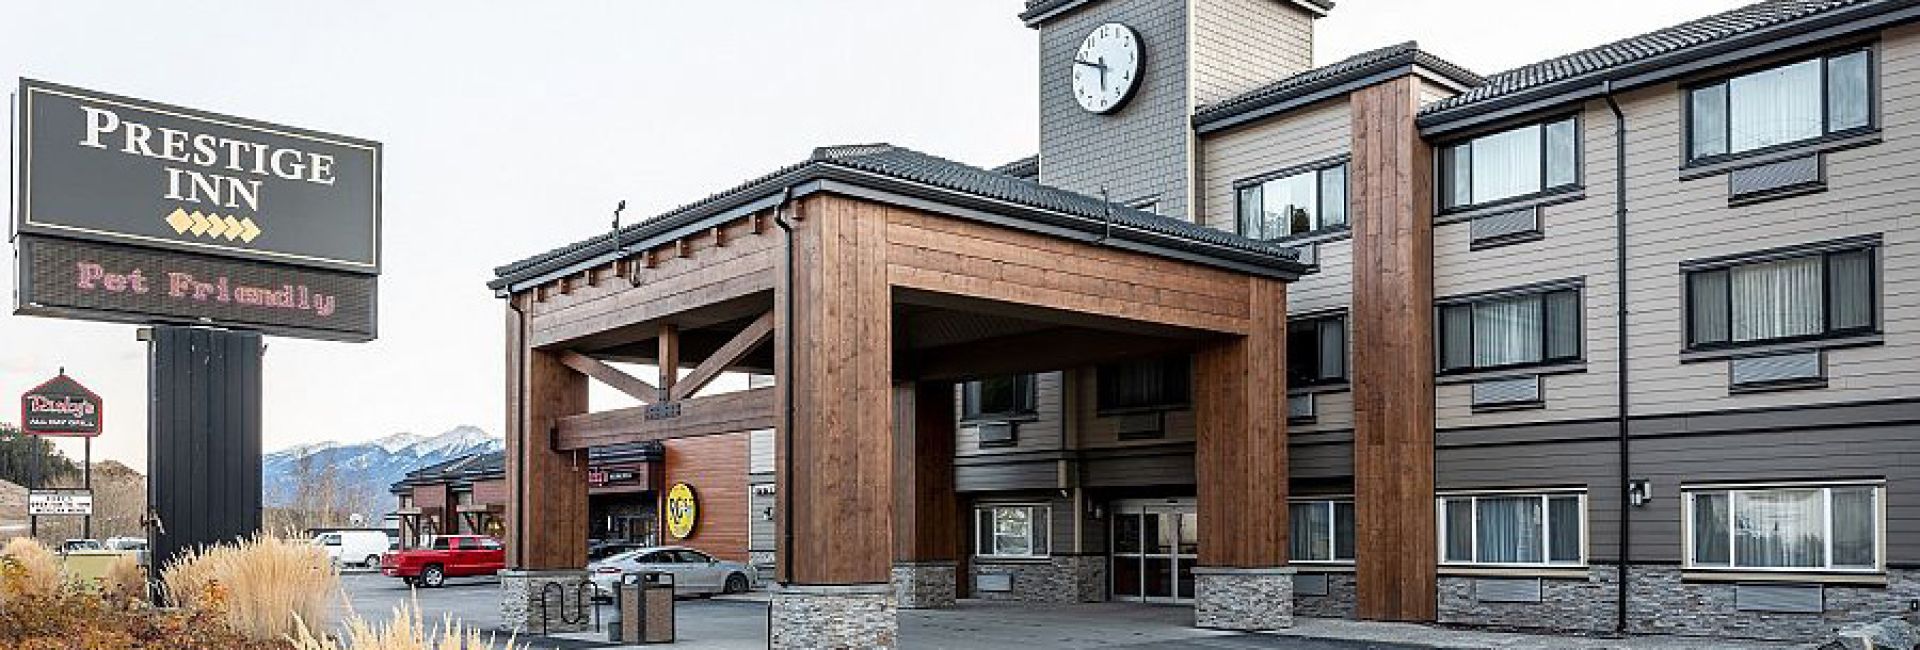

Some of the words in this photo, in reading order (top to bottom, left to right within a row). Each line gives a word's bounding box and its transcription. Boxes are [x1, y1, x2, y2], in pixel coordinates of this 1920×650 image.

[78, 105, 336, 186] PRESTIGE
[164, 166, 263, 211] INN
[77, 261, 148, 294] Pet
[167, 272, 336, 317] Friendly
